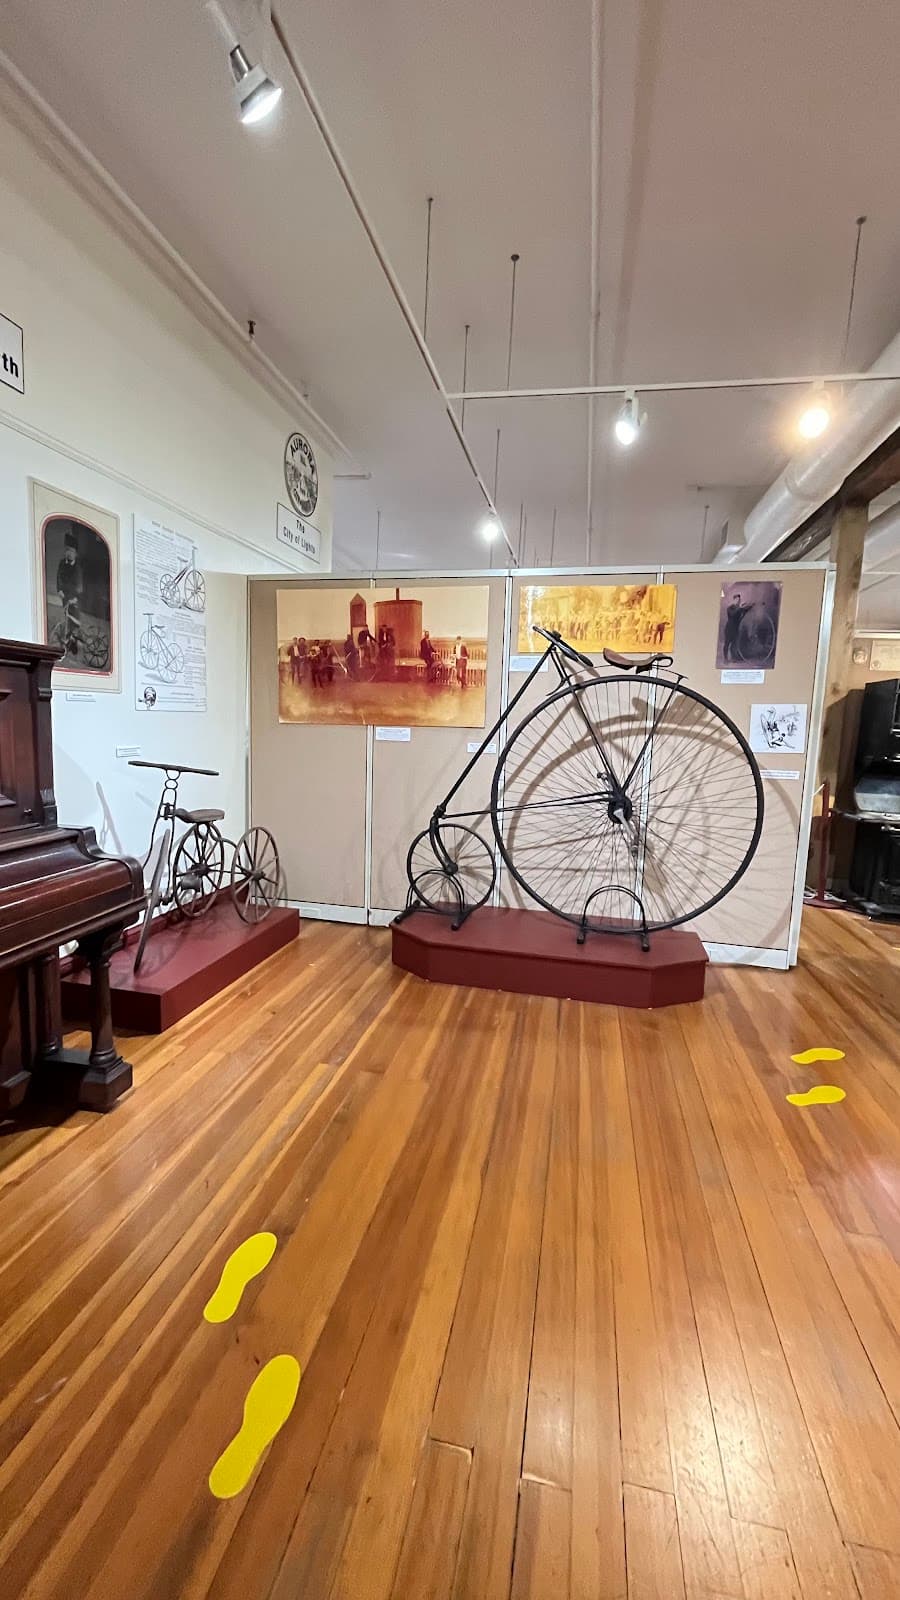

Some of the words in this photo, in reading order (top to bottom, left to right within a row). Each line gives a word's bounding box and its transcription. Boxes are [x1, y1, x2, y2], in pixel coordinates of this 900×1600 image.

[290, 438, 315, 475] AURORA
[283, 526, 294, 543] City
[296, 519, 305, 534] The
